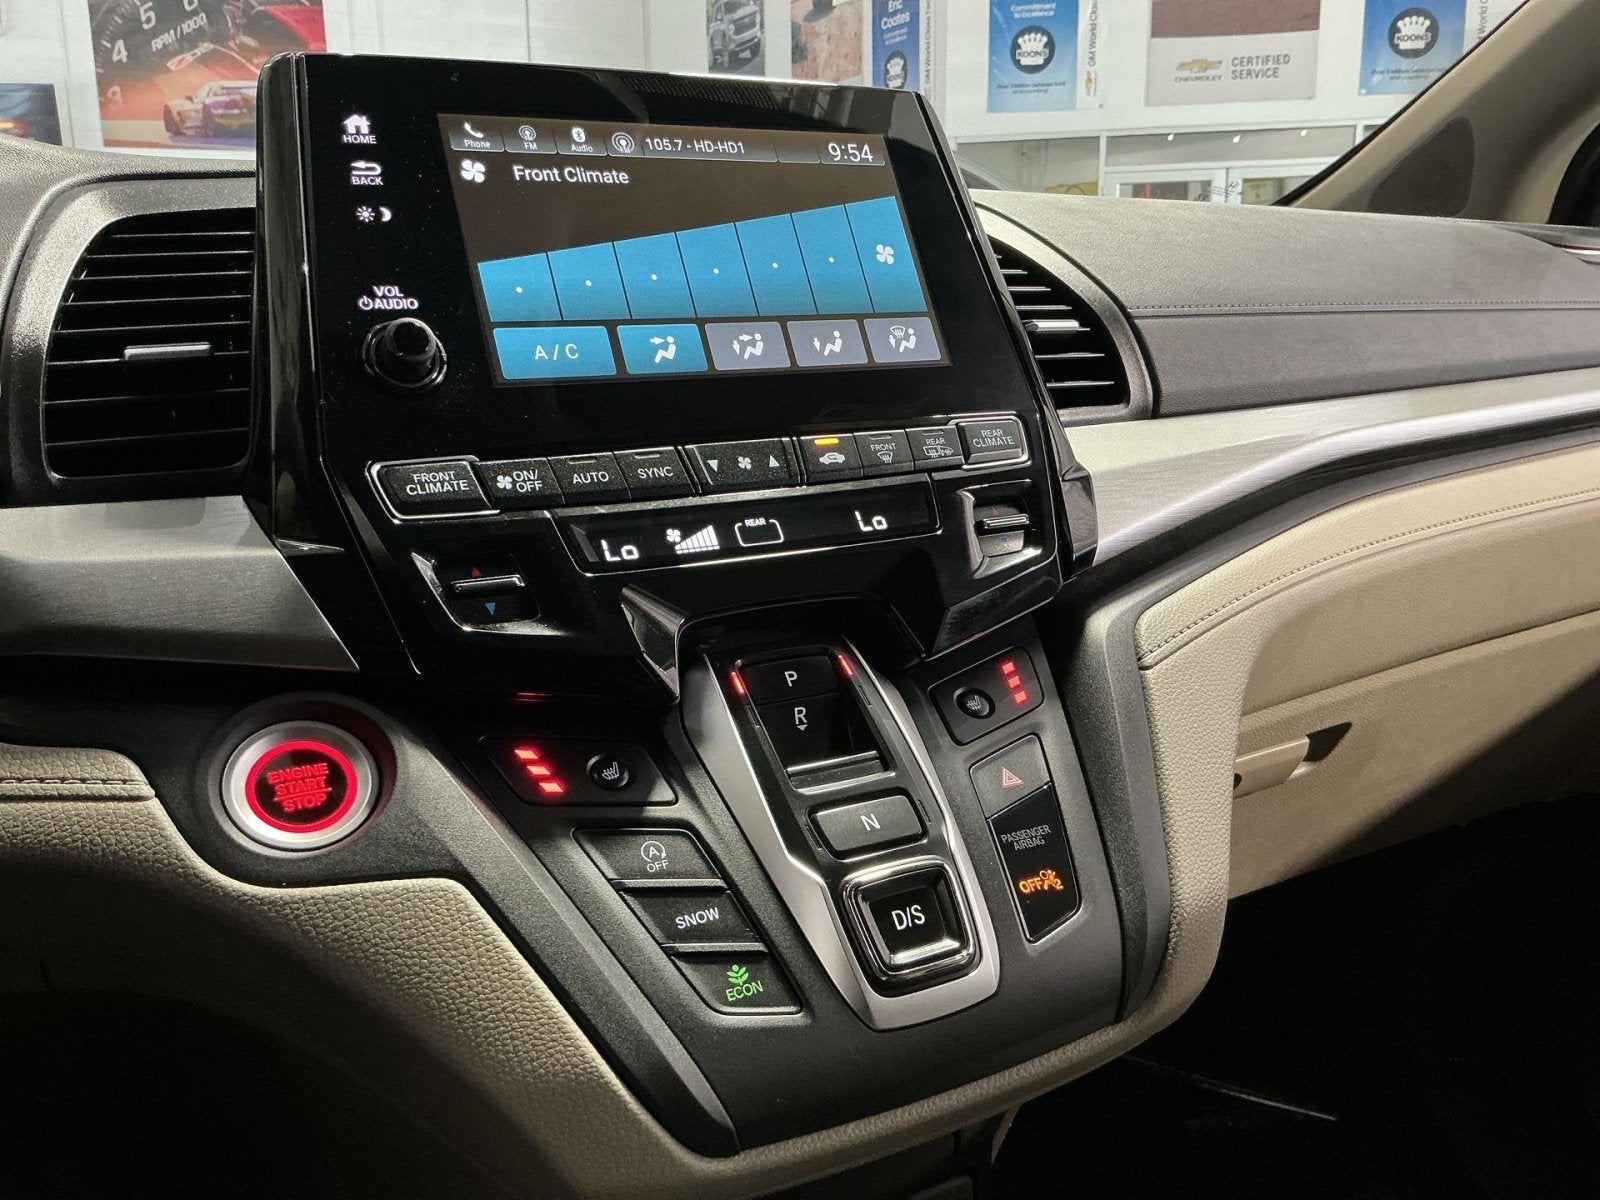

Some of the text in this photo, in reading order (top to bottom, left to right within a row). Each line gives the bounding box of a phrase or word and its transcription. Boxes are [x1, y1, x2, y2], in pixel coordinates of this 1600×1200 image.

[140, 1, 156, 30] 5
[1088, 23, 1097, 50] World
[1397, 33, 1430, 42] KOONS
[112, 39, 128, 63] 4
[1017, 50, 1048, 59] KOONS
[1231, 53, 1291, 68] CERTIFIED
[1231, 67, 1279, 80] SERVICE
[343, 135, 377, 144] HOME
[464, 139, 490, 149] Phone
[524, 142, 538, 151] FM
[645, 138, 683, 152] 105.7
[694, 140, 746, 154] HD-HD1
[571, 144, 593, 152] Audio
[827, 142, 874, 163] 9:54
[352, 176, 383, 186] BACK
[513, 165, 630, 184] Front Climate
[373, 285, 404, 297] VOL
[374, 298, 419, 310] AUDIO
[980, 428, 1004, 438] REAR
[870, 442, 896, 452] FRONT
[925, 437, 946, 446] REAR
[972, 435, 1015, 448] CLIMATE
[413, 470, 456, 482] FRONT
[513, 470, 539, 483] ON/
[572, 471, 609, 485] AUTO
[637, 466, 674, 479] SYNC
[406, 480, 470, 496] CLIMATE
[516, 480, 543, 493] OFF
[744, 517, 767, 527] REAR
[784, 670, 798, 687] P
[794, 706, 808, 725] R
[267, 763, 329, 784] ENGINE
[275, 776, 326, 795] START
[283, 793, 327, 812] STOP
[860, 813, 881, 831] N
[1000, 824, 1052, 844] PASSENGER
[1013, 835, 1046, 851] AIRBAG
[646, 859, 669, 873] OFF
[1019, 877, 1042, 893] OFF
[675, 906, 720, 929] SNOW
[891, 904, 926, 931] D/S
[725, 980, 764, 1002] ECON
